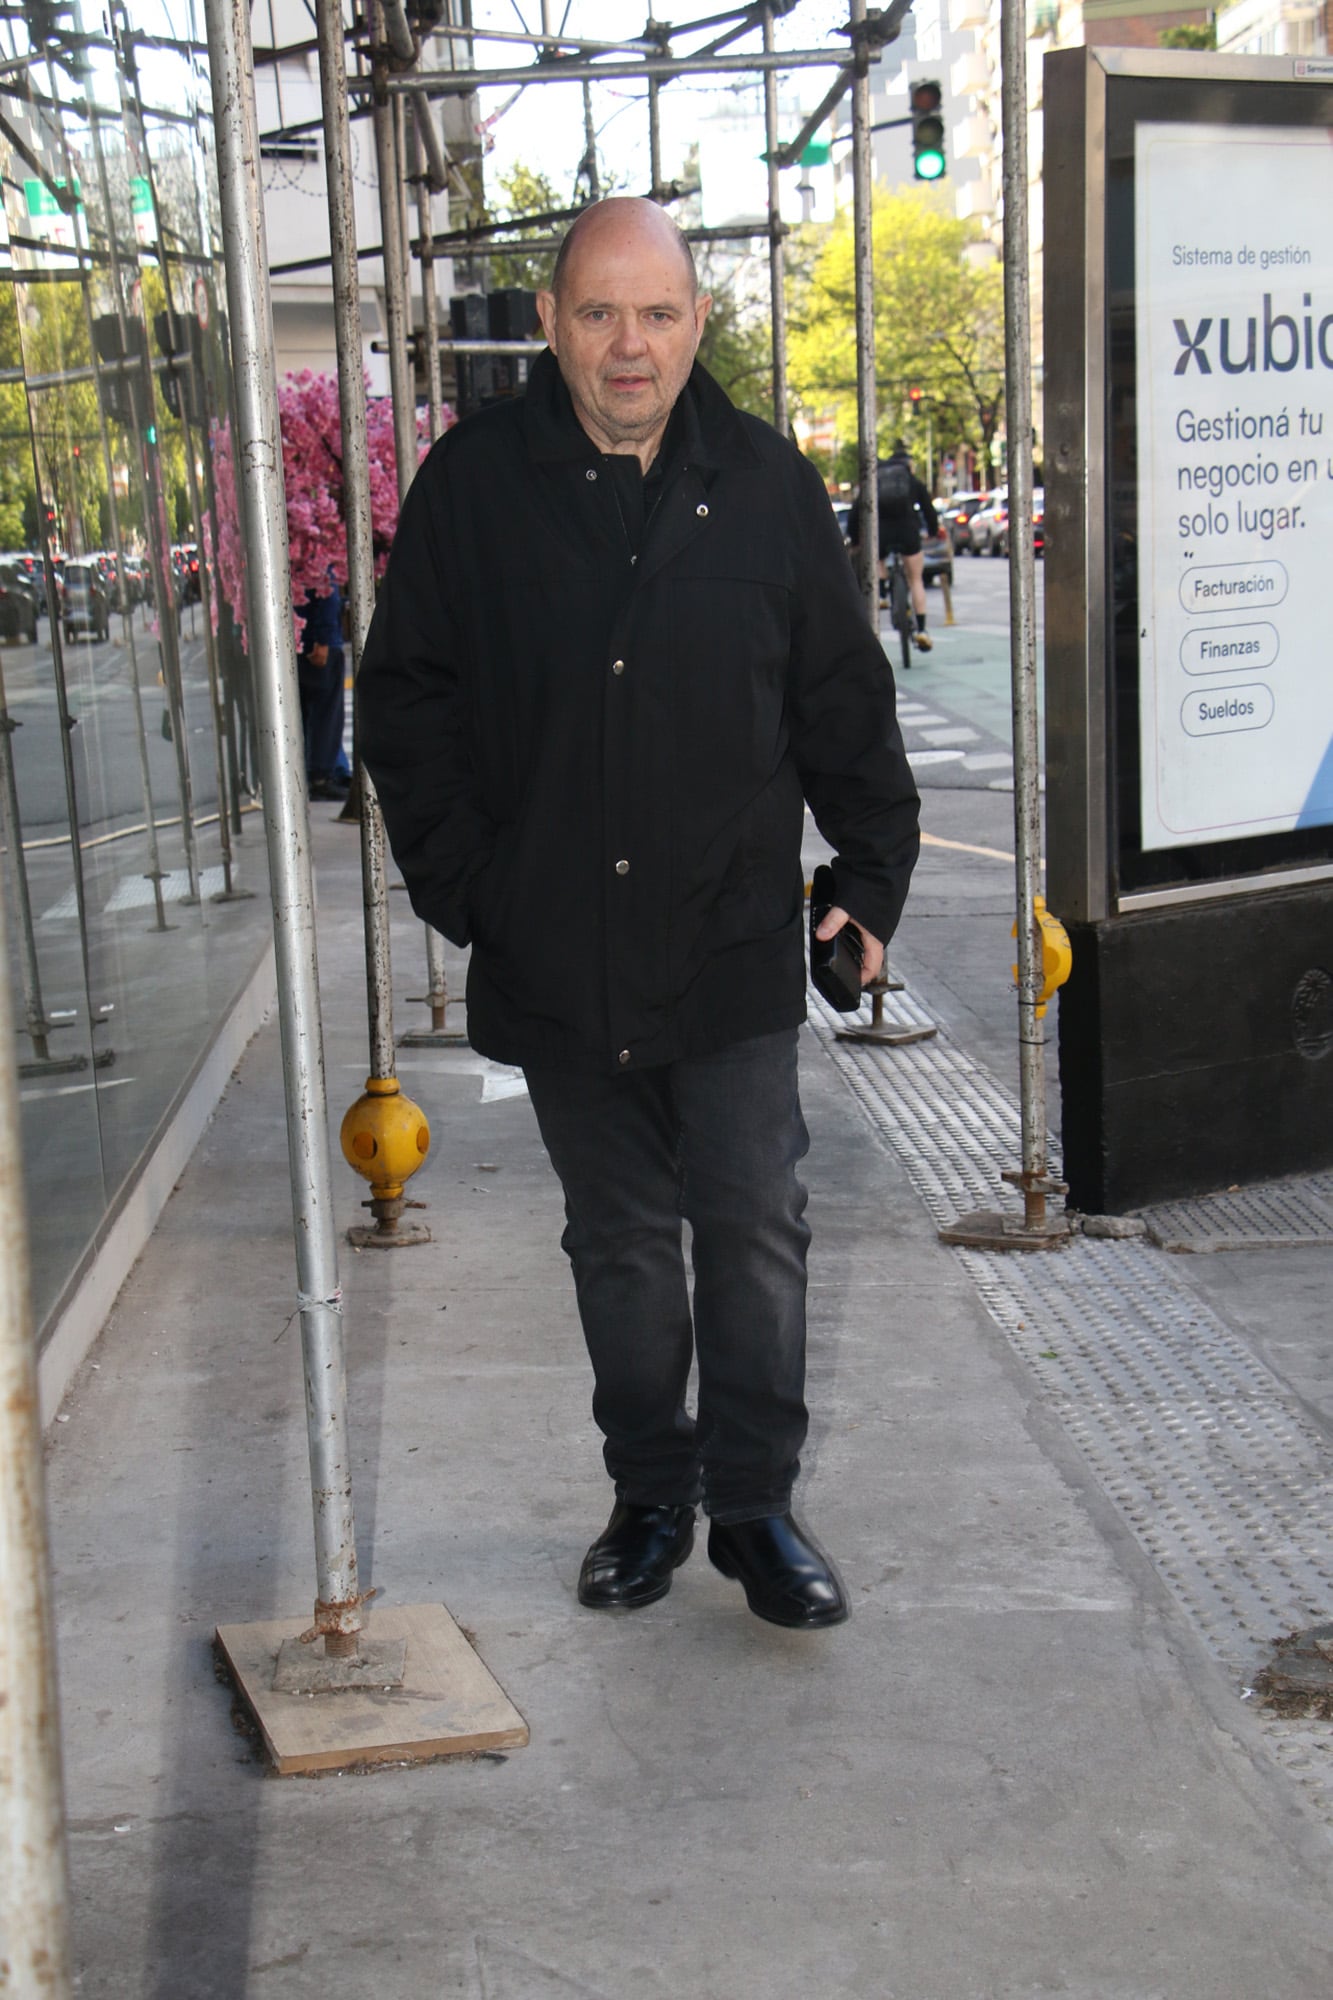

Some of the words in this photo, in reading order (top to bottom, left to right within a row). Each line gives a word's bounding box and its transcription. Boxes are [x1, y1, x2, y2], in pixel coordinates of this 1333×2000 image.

[1172, 244, 1233, 266] Sistema
[1237, 244, 1256, 265] de
[1260, 244, 1311, 270] gestión
[1176, 406, 1290, 443] Gestioná
[1299, 407, 1323, 436] tu
[1177, 452, 1279, 498] negocio
[1287, 458, 1318, 483] en
[1178, 502, 1229, 538] solo
[1238, 500, 1306, 541] lugar.
[1194, 574, 1275, 598] Facturación
[1200, 639, 1261, 660] Finanzas
[1198, 699, 1255, 721] Sueldos
